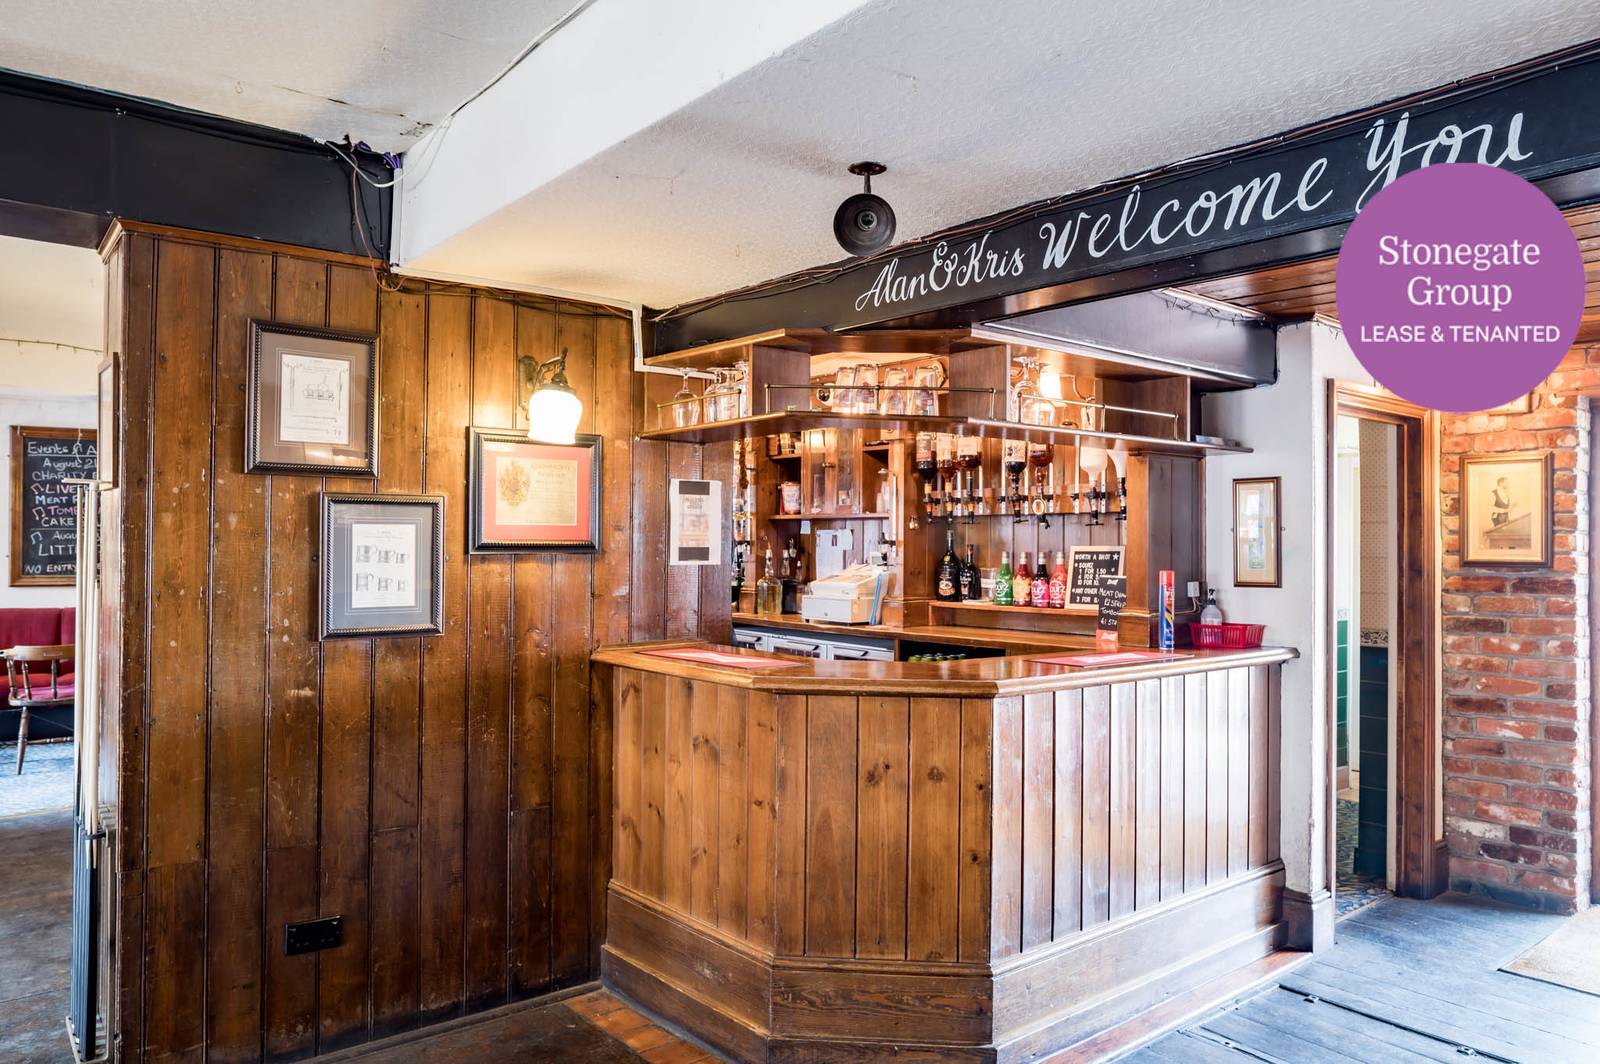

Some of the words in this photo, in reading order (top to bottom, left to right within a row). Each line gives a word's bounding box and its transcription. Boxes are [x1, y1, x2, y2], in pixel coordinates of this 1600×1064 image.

[1039, 157, 1334, 270] Welcome
[27, 441, 69, 454] Events
[43, 457, 82, 471] August
[32, 470, 86, 482] CHARITY
[35, 495, 68, 505] MEAT
[41, 517, 75, 527] CAKE
[38, 543, 77, 556] LITT
[25, 564, 42, 574] NO
